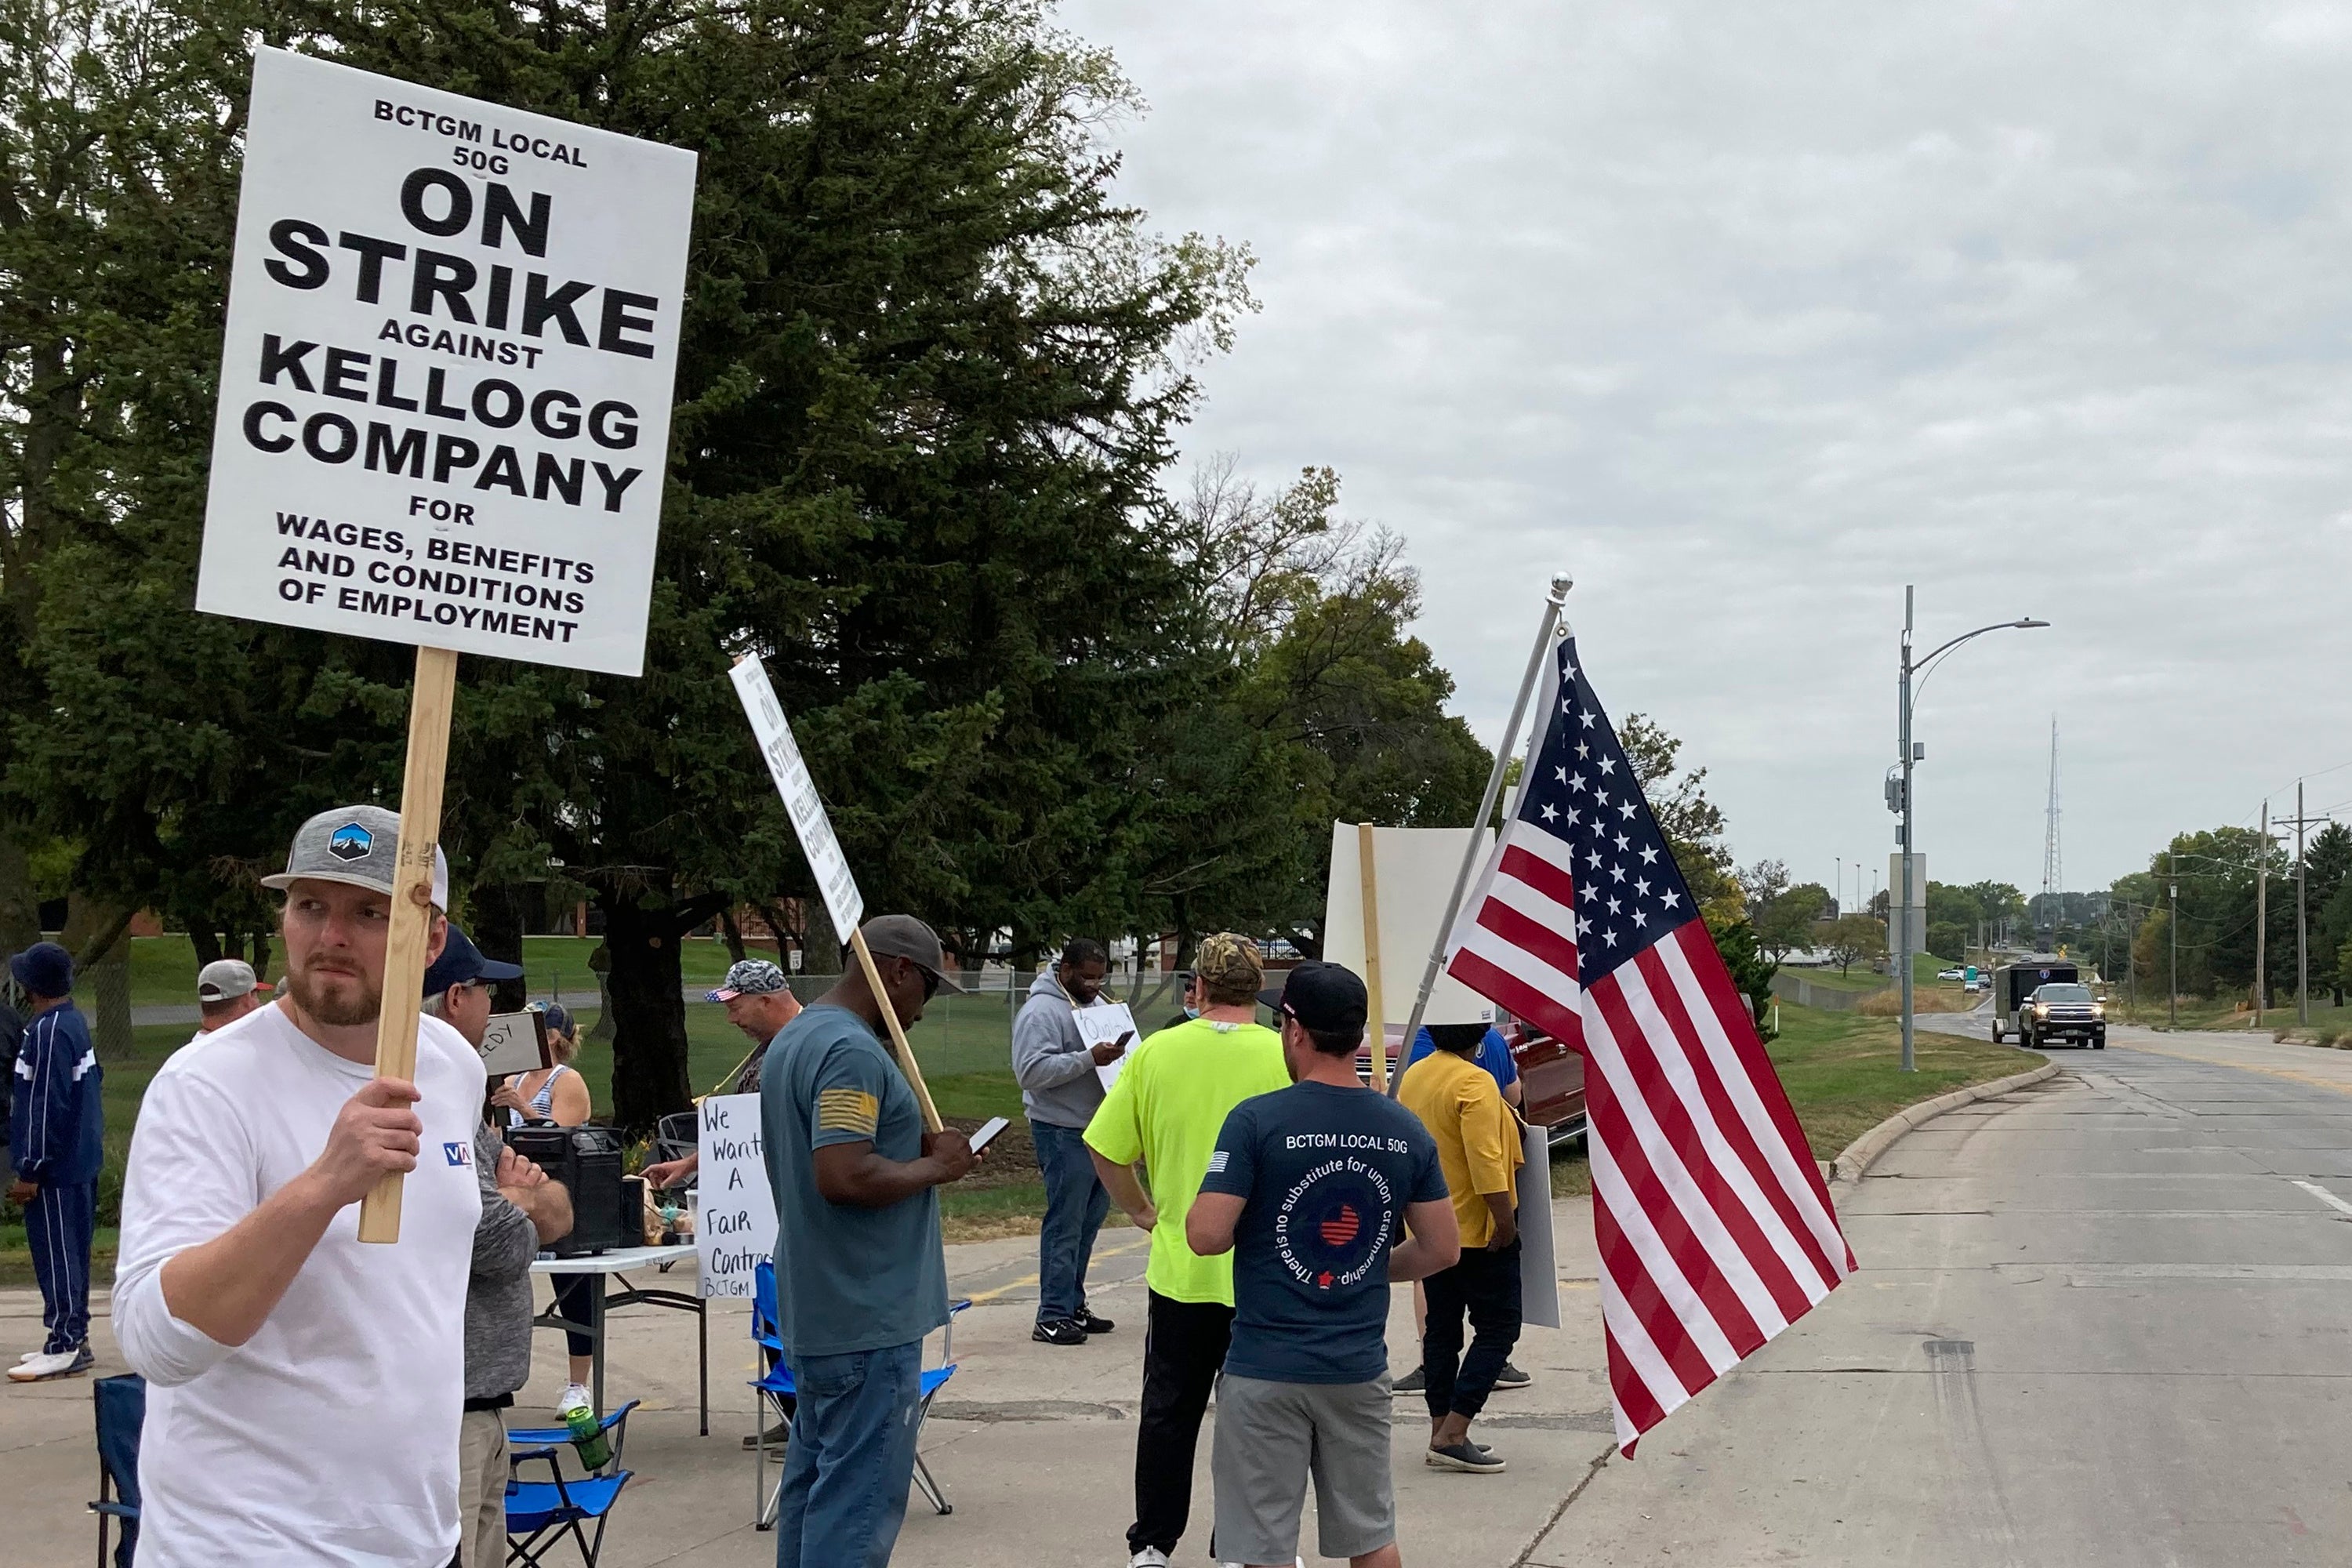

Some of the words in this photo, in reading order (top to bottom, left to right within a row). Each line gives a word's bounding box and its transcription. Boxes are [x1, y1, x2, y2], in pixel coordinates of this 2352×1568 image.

[374, 99, 482, 143] BCTGM
[492, 129, 588, 169] LOCAL
[452, 147, 509, 176] 50G
[400, 167, 552, 258] ON
[263, 218, 659, 359] STRIKE
[378, 318, 543, 368] AGAINST
[259, 333, 639, 449] KELLOGG
[243, 401, 643, 514] COMPANY
[409, 495, 474, 526] FOR
[276, 512, 412, 561] WAGES,
[427, 538, 595, 584] BENEFITS
[278, 547, 355, 578] AND
[368, 561, 584, 614] CONDITIONS
[278, 578, 326, 604] OF
[339, 588, 579, 643] EMPLOYMENT
[705, 1103, 730, 1132] We
[713, 1132, 761, 1162] Want
[1287, 1134, 1337, 1149] BCTGM
[1341, 1134, 1385, 1150] LOCAL
[1388, 1138, 1408, 1154] 50G
[728, 1167, 744, 1191] A
[1347, 1156, 1367, 1173] for
[1281, 1160, 1344, 1212] substitute
[1367, 1167, 1392, 1204] union
[1276, 1215, 1289, 1232] no
[1275, 1236, 1290, 1249] is
[1280, 1249, 1313, 1284] There
[704, 1277, 749, 1298] BCTGM
